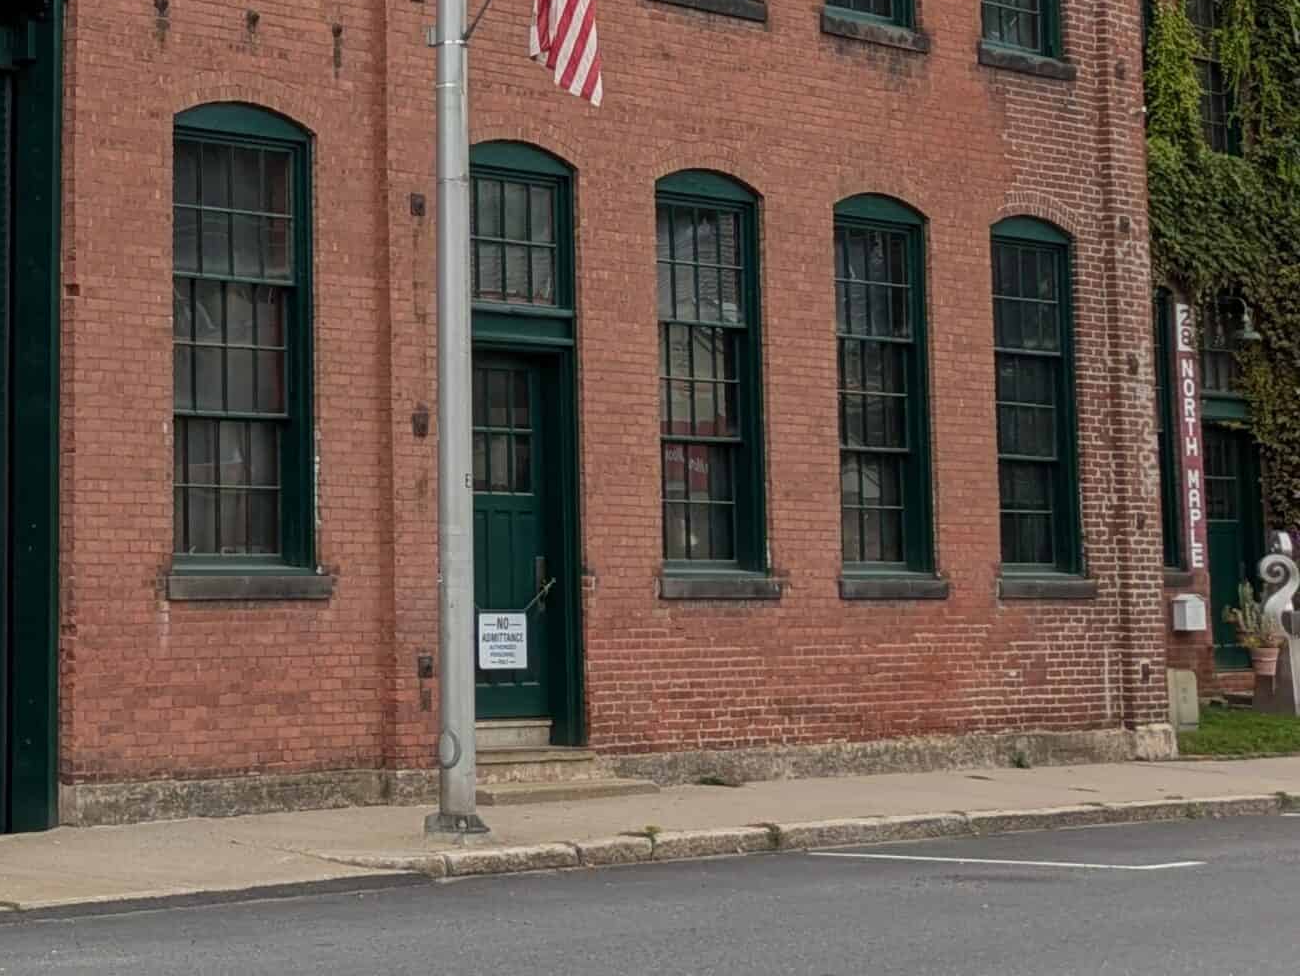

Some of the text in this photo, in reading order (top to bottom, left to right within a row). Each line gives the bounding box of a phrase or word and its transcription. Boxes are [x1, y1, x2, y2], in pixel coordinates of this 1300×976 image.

[1179, 308, 1204, 568] 28 NORTH MAPLE
[497, 616, 509, 630] NO
